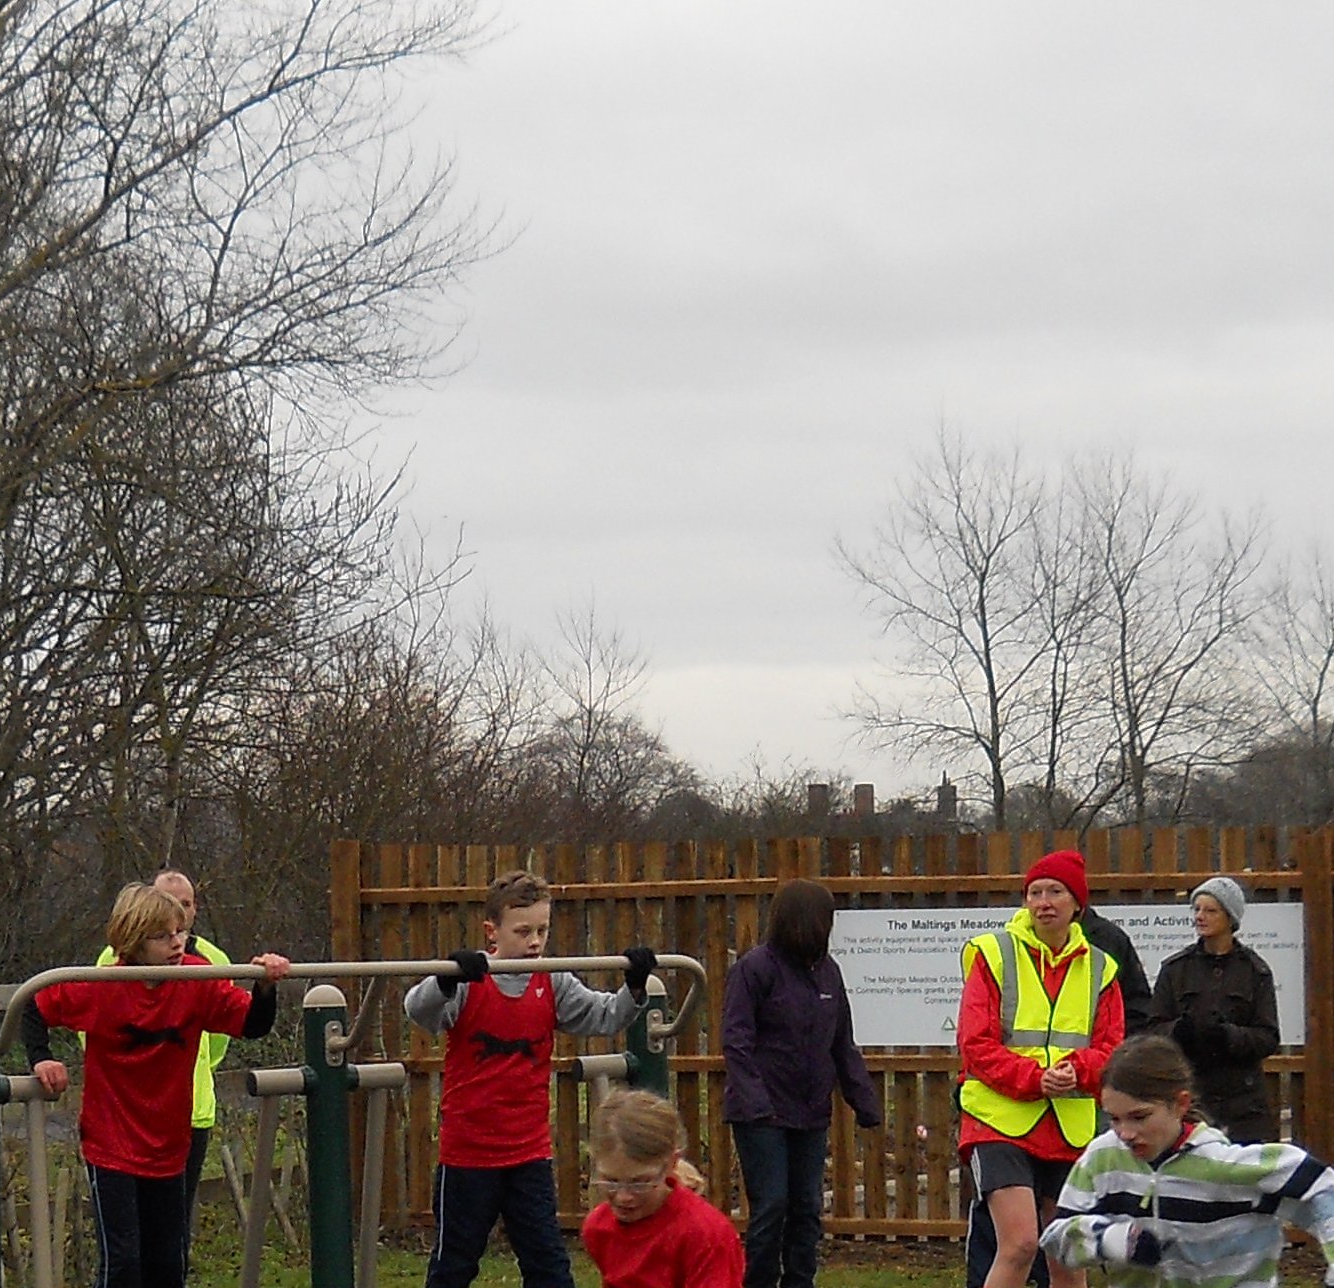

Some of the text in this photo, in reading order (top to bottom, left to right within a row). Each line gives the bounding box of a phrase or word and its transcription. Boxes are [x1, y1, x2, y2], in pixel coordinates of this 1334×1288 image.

[888, 920, 908, 930] The
[911, 919, 956, 932] Maltings
[1129, 916, 1149, 926] and
[1154, 915, 1196, 928] Activity
